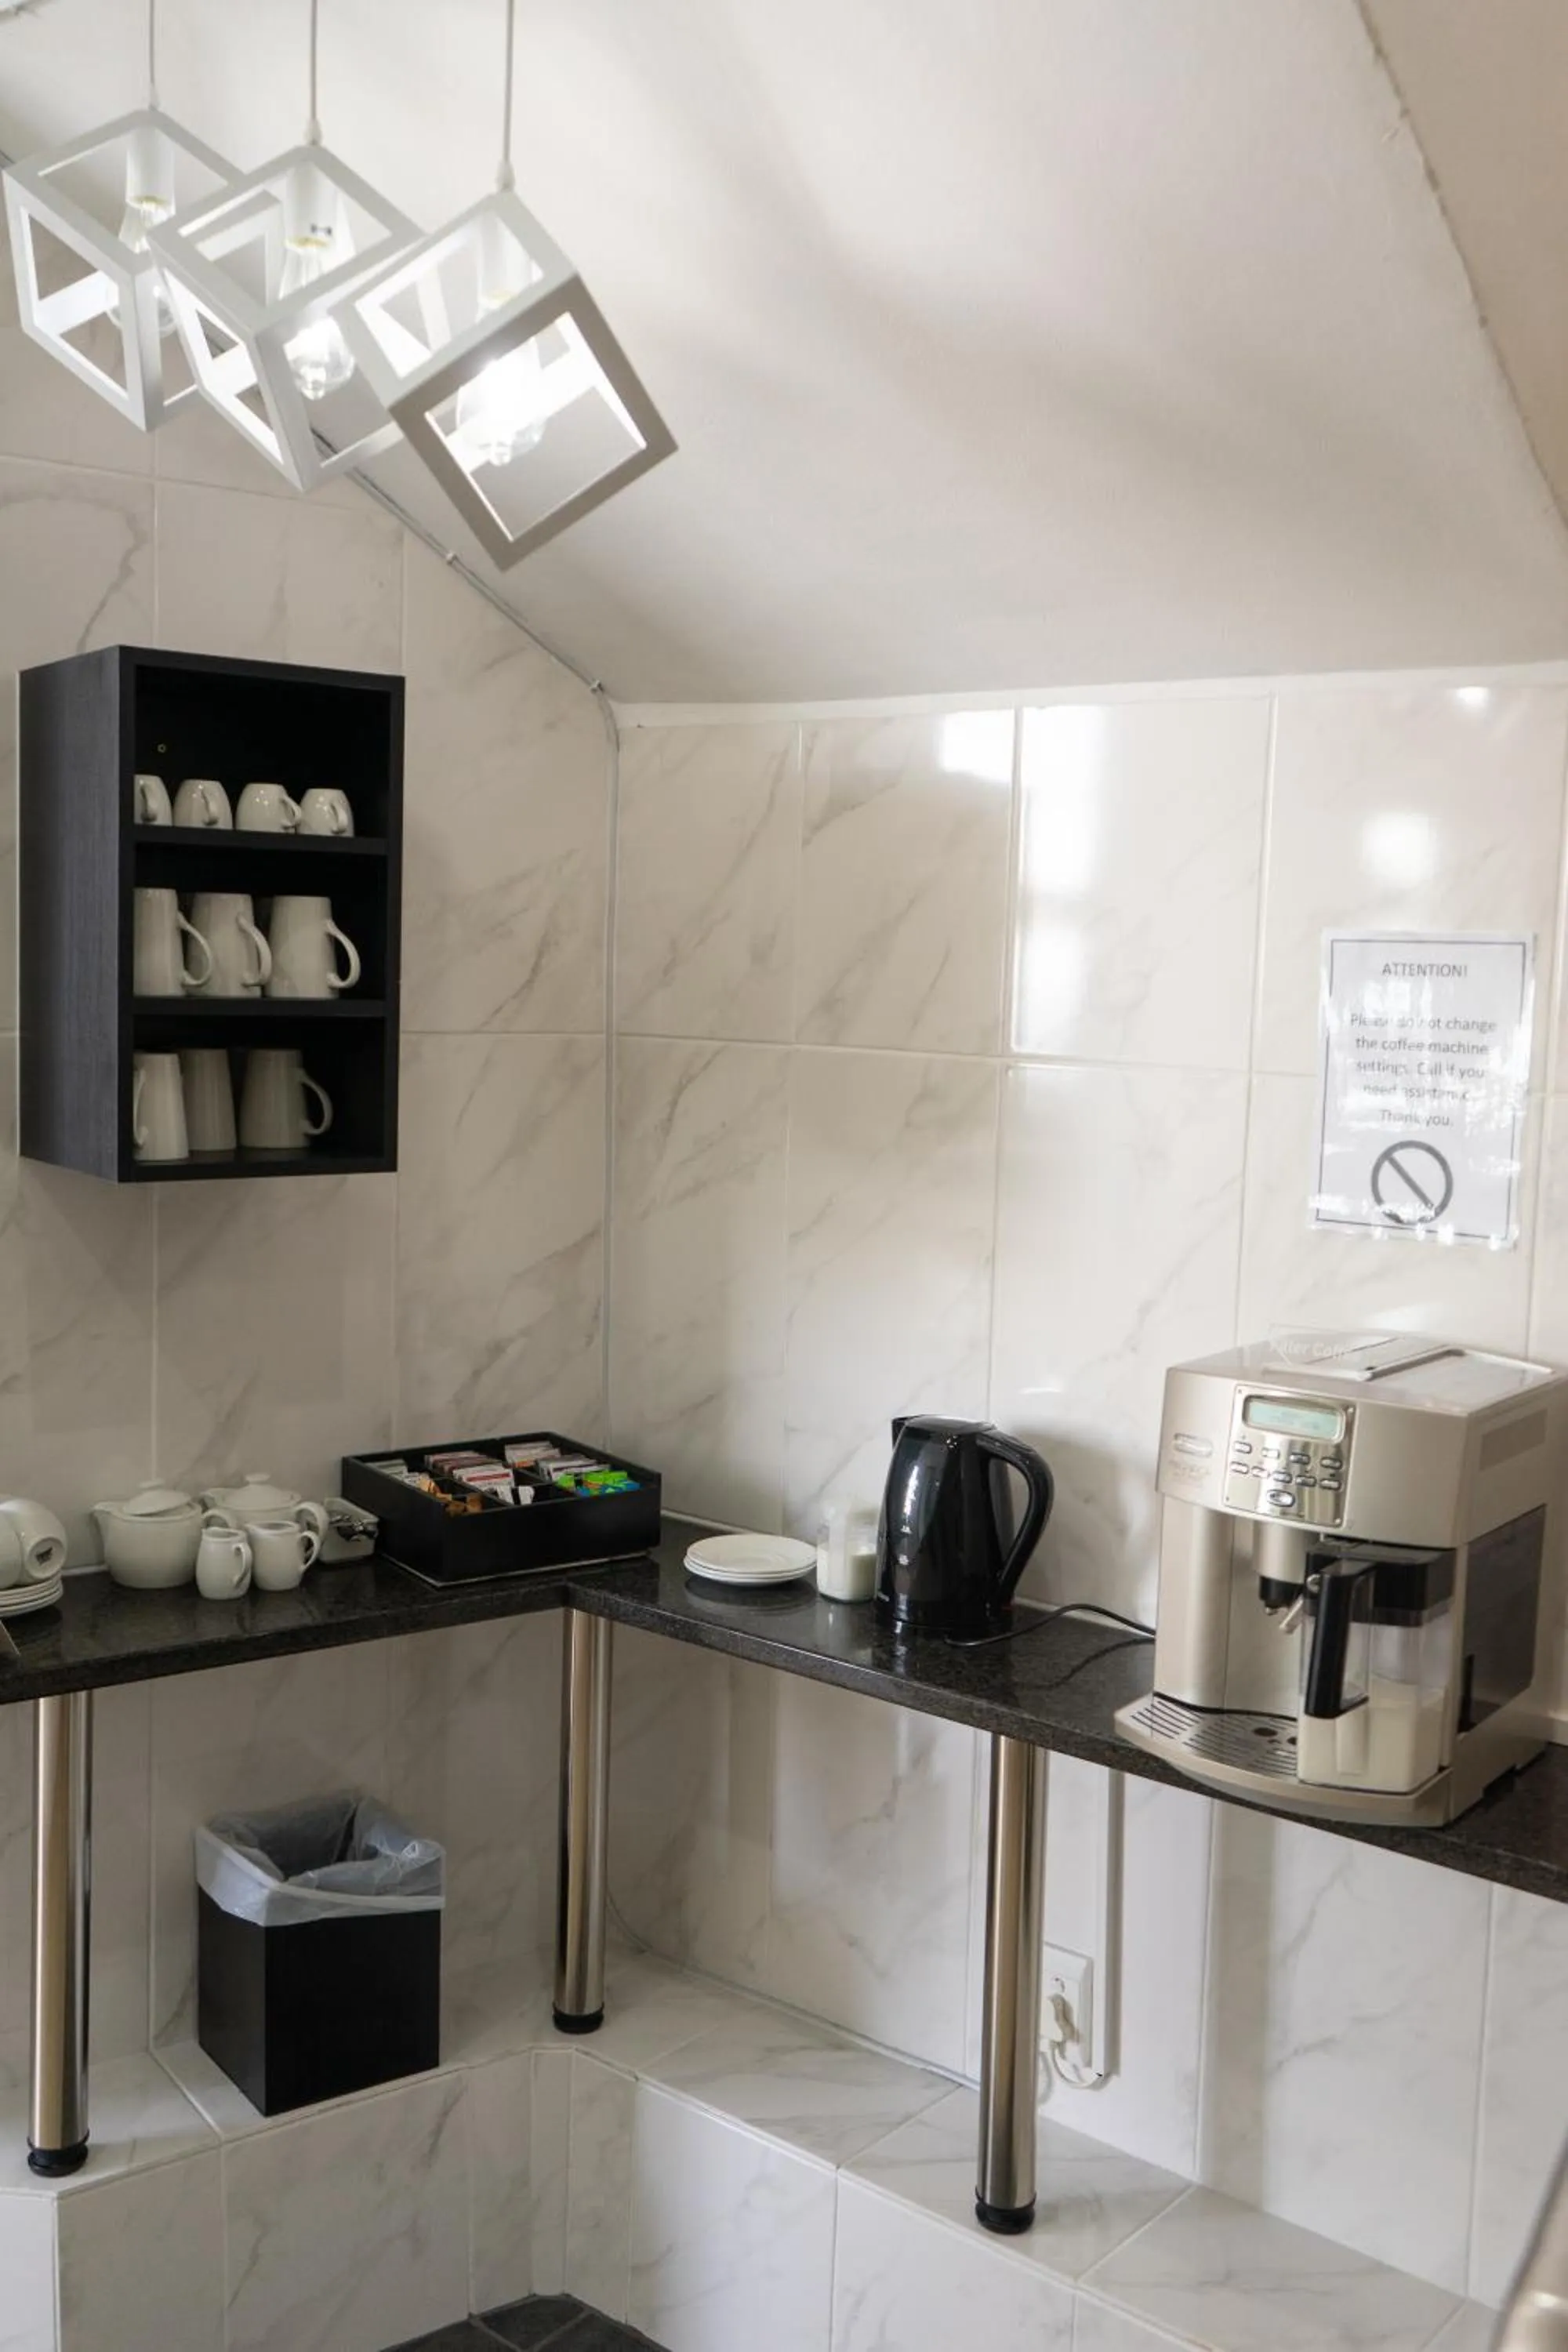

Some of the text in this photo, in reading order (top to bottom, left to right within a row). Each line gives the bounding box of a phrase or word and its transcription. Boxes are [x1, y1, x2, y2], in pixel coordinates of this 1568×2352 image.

[1381, 962, 1468, 978] ATTENTION!
[1445, 1016, 1498, 1034] change
[1356, 1035, 1490, 1054] the coffee machine
[1458, 1068, 1486, 1080] you
[1380, 1109, 1421, 1124] Thank
